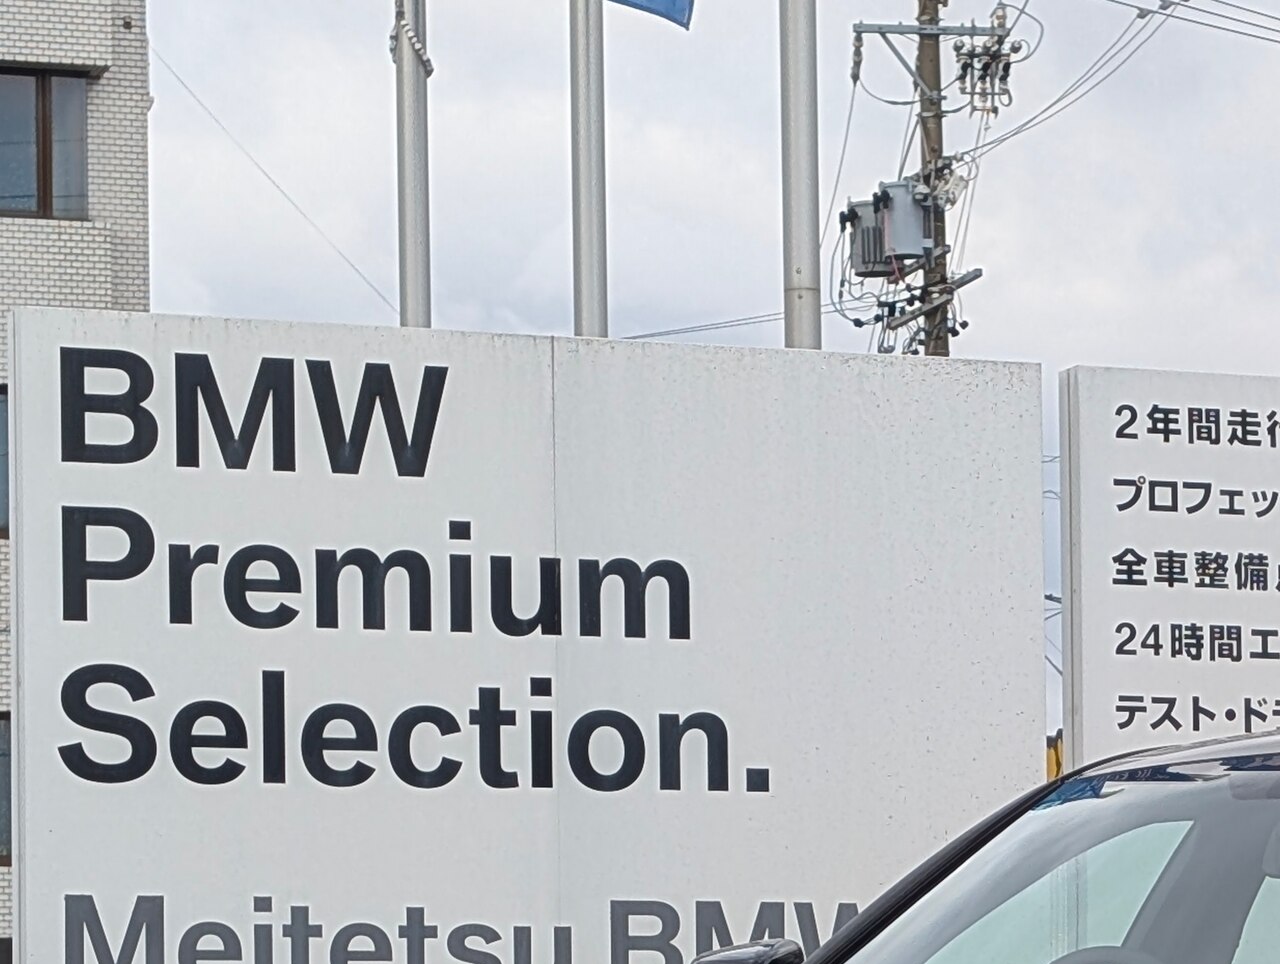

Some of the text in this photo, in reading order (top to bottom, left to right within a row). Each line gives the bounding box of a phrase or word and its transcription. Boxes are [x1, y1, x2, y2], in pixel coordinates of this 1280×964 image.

[60, 347, 448, 477] BMW
[61, 506, 691, 639] Premium
[58, 664, 769, 792] Selection.
